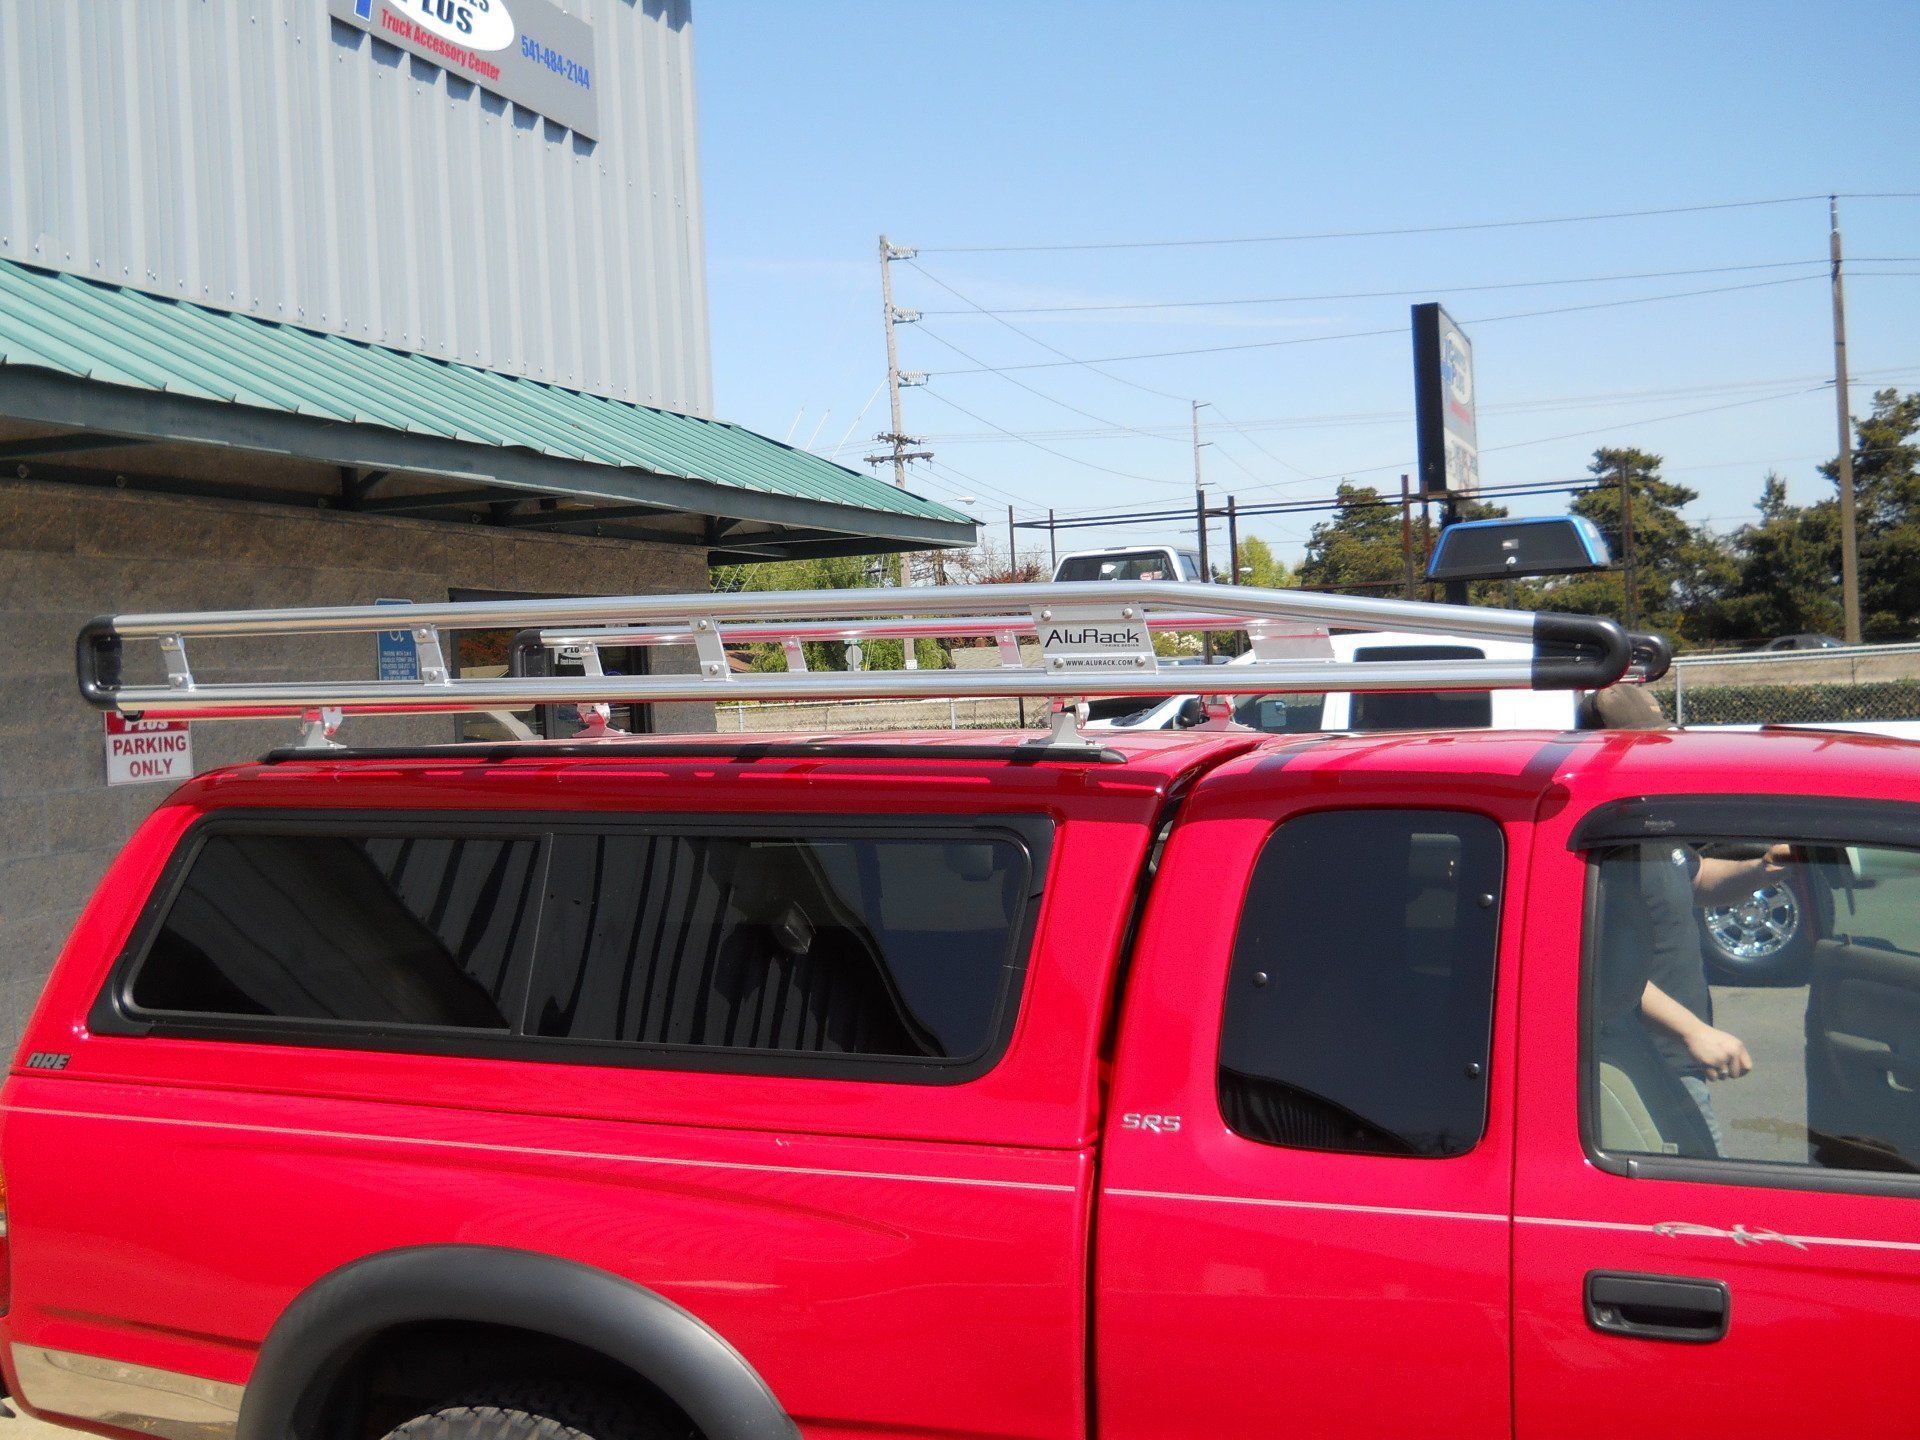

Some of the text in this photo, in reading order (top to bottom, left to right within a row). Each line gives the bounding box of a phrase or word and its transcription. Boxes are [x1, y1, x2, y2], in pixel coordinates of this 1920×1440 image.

[382, 9, 501, 81] Truck Accessory Center
[521, 34, 590, 90] 541-484-2144
[1045, 629, 1139, 648] AluRack
[113, 735, 187, 756] PARKING
[129, 758, 173, 777] ONLY
[26, 1052, 71, 1070] ARE
[1121, 1113, 1181, 1133] SRS
